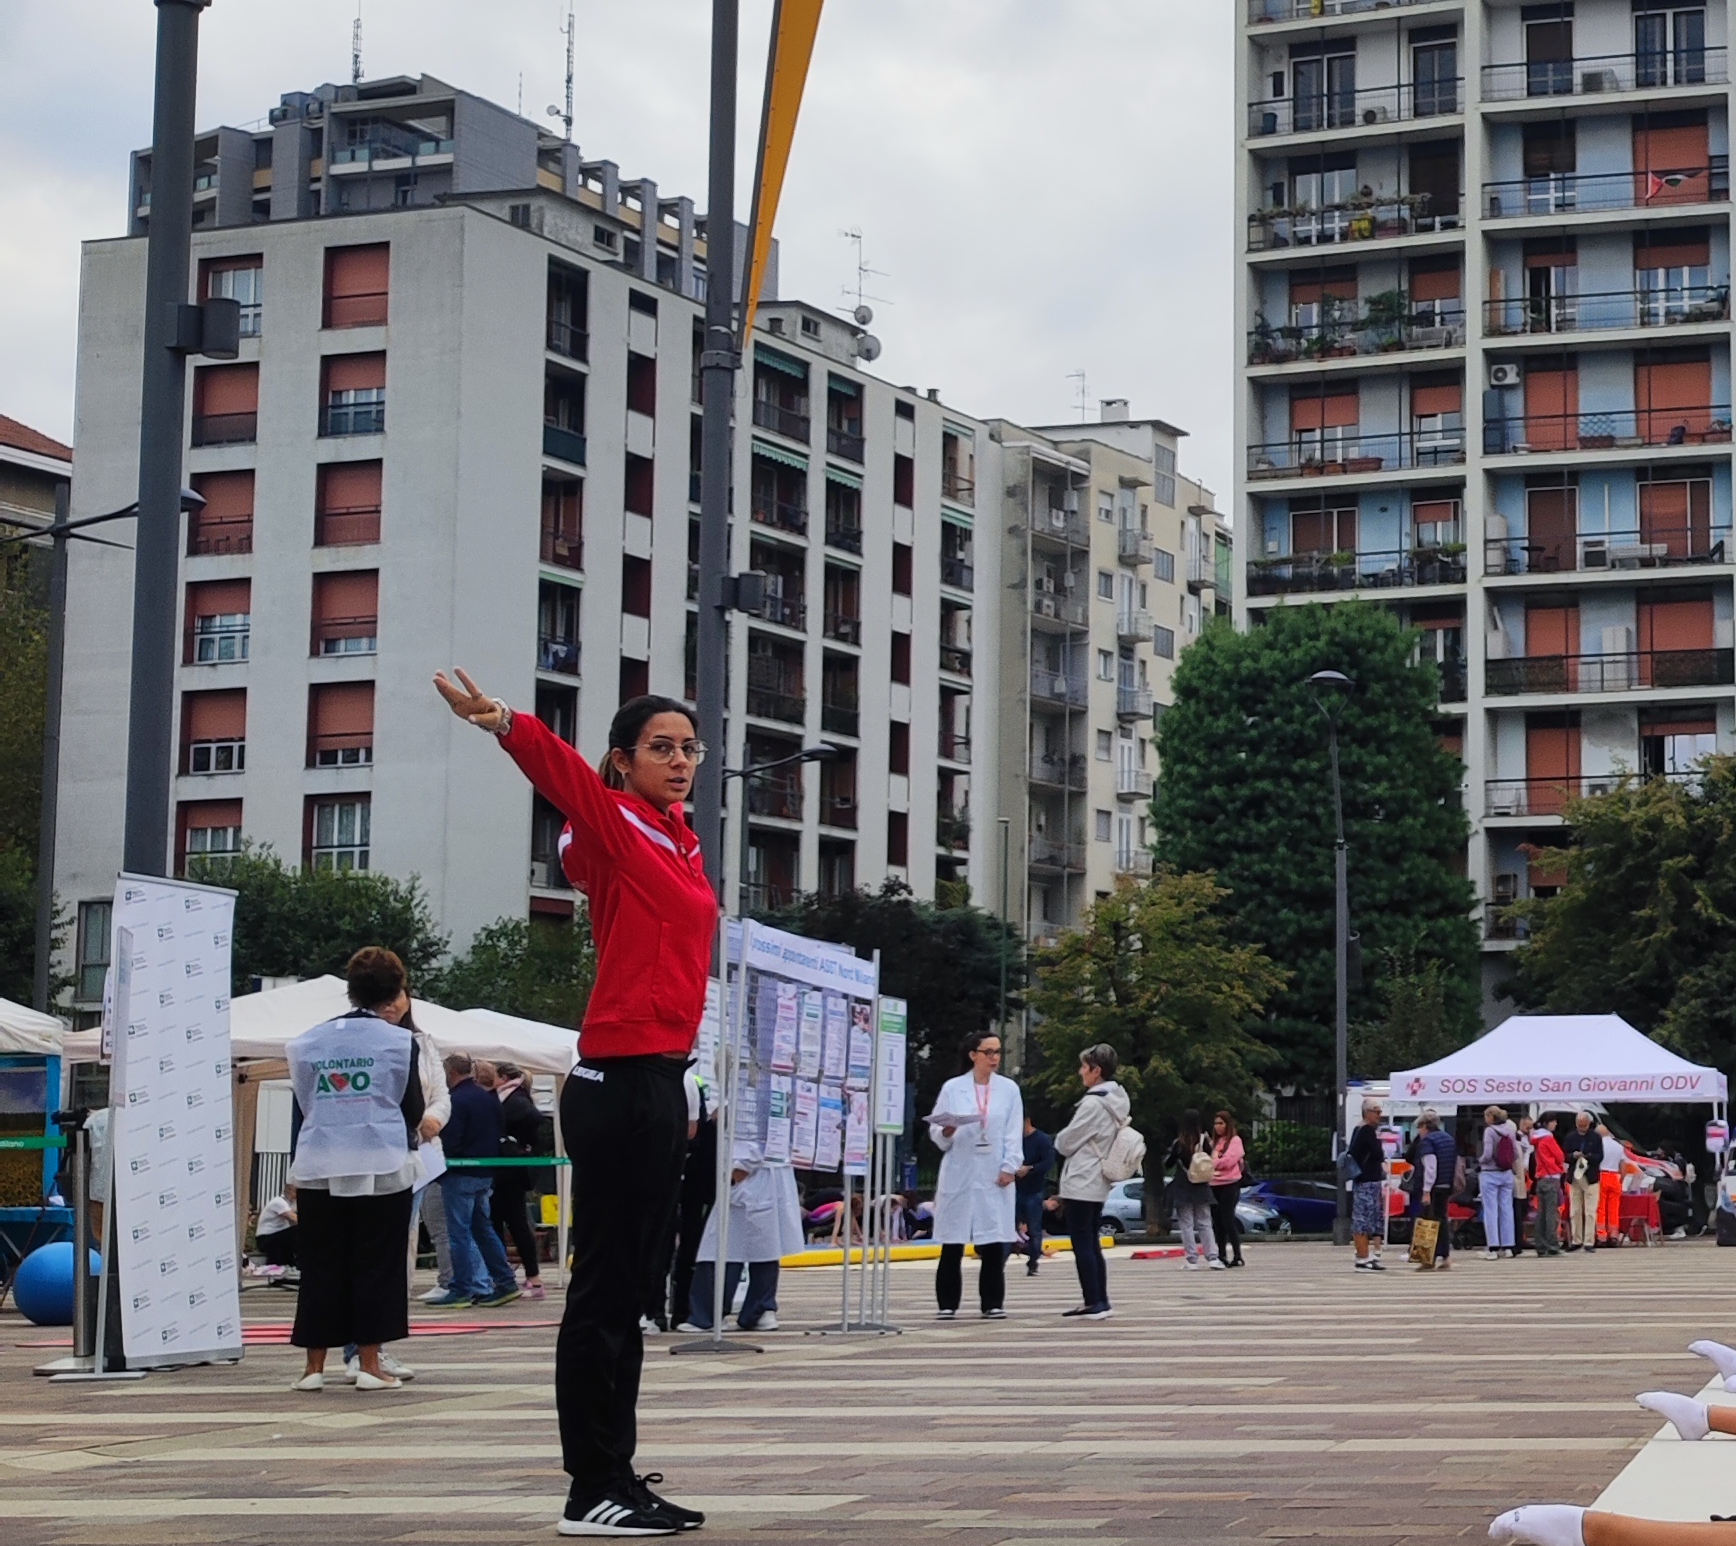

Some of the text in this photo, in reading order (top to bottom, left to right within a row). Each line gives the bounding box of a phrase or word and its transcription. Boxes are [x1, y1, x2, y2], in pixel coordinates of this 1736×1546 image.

[310, 1057, 375, 1071] VOLONTARIO
[1439, 1079, 1478, 1093] SOS
[1484, 1078, 1533, 1093] Sesto
[1539, 1077, 1572, 1092] San
[1578, 1076, 1654, 1093] Giovanni
[1660, 1075, 1701, 1091] ODV
